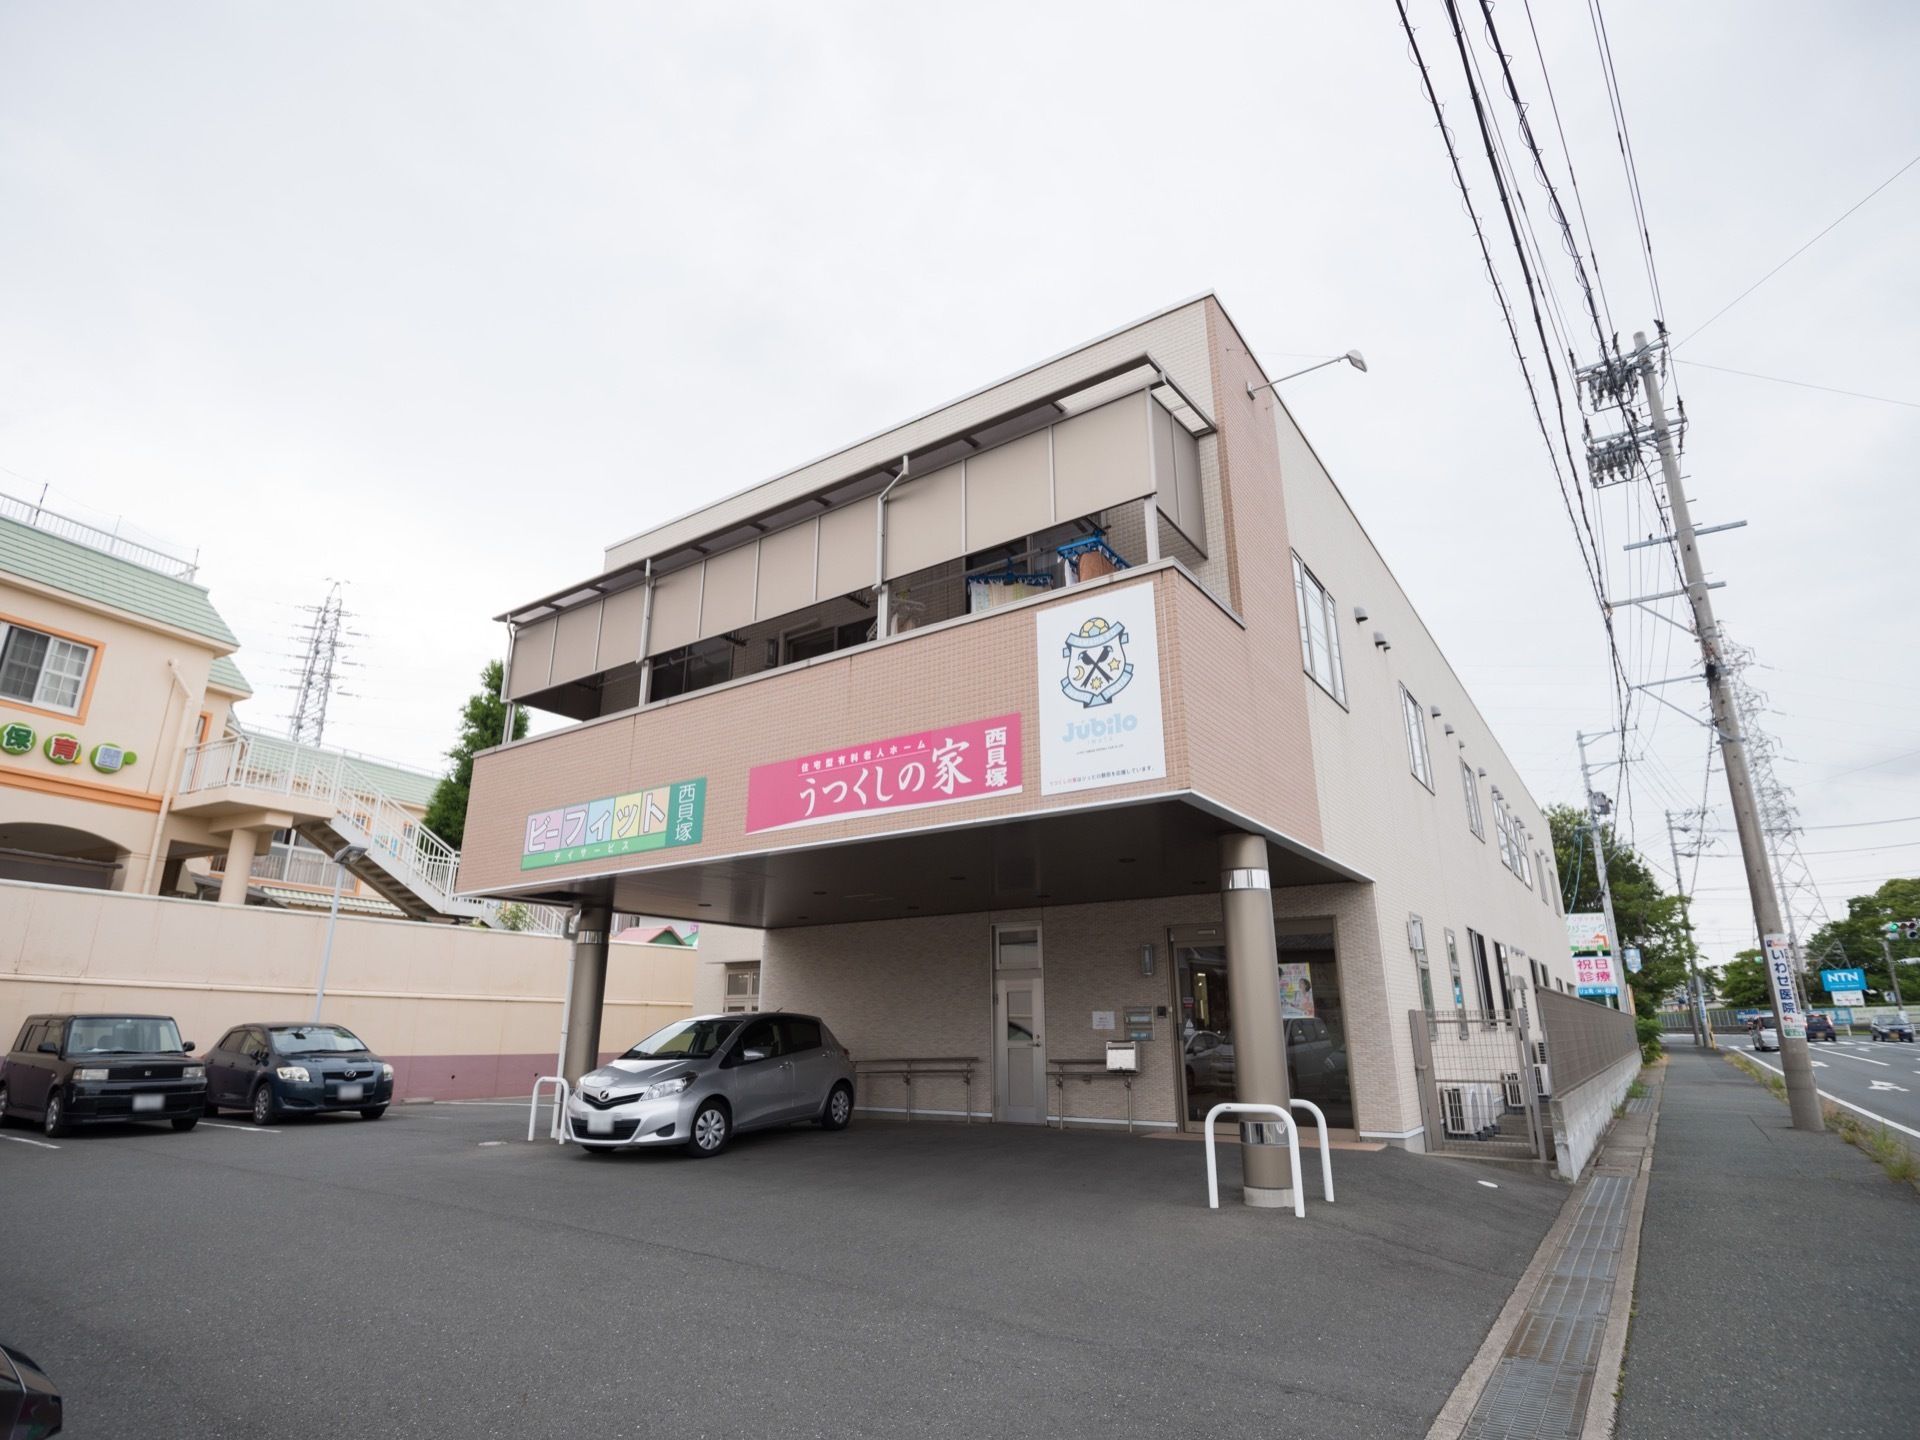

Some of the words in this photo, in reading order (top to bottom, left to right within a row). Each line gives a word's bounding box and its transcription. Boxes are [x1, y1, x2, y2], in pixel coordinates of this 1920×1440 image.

[1062, 713, 1138, 742] Jubilo
[801, 740, 926, 772] 住宅型有料老人ホーム
[984, 727, 1007, 787] 西貝塚
[800, 737, 972, 817] うつくしの家
[527, 793, 666, 852] ビーフィット
[675, 783, 696, 841] 西貝塚
[553, 840, 630, 864] デイサービス
[1577, 959, 1608, 970] 祝日
[1578, 971, 1610, 982] 診療
[1827, 972, 1858, 982] NTN
[1772, 950, 1795, 1013] いわせ医院
